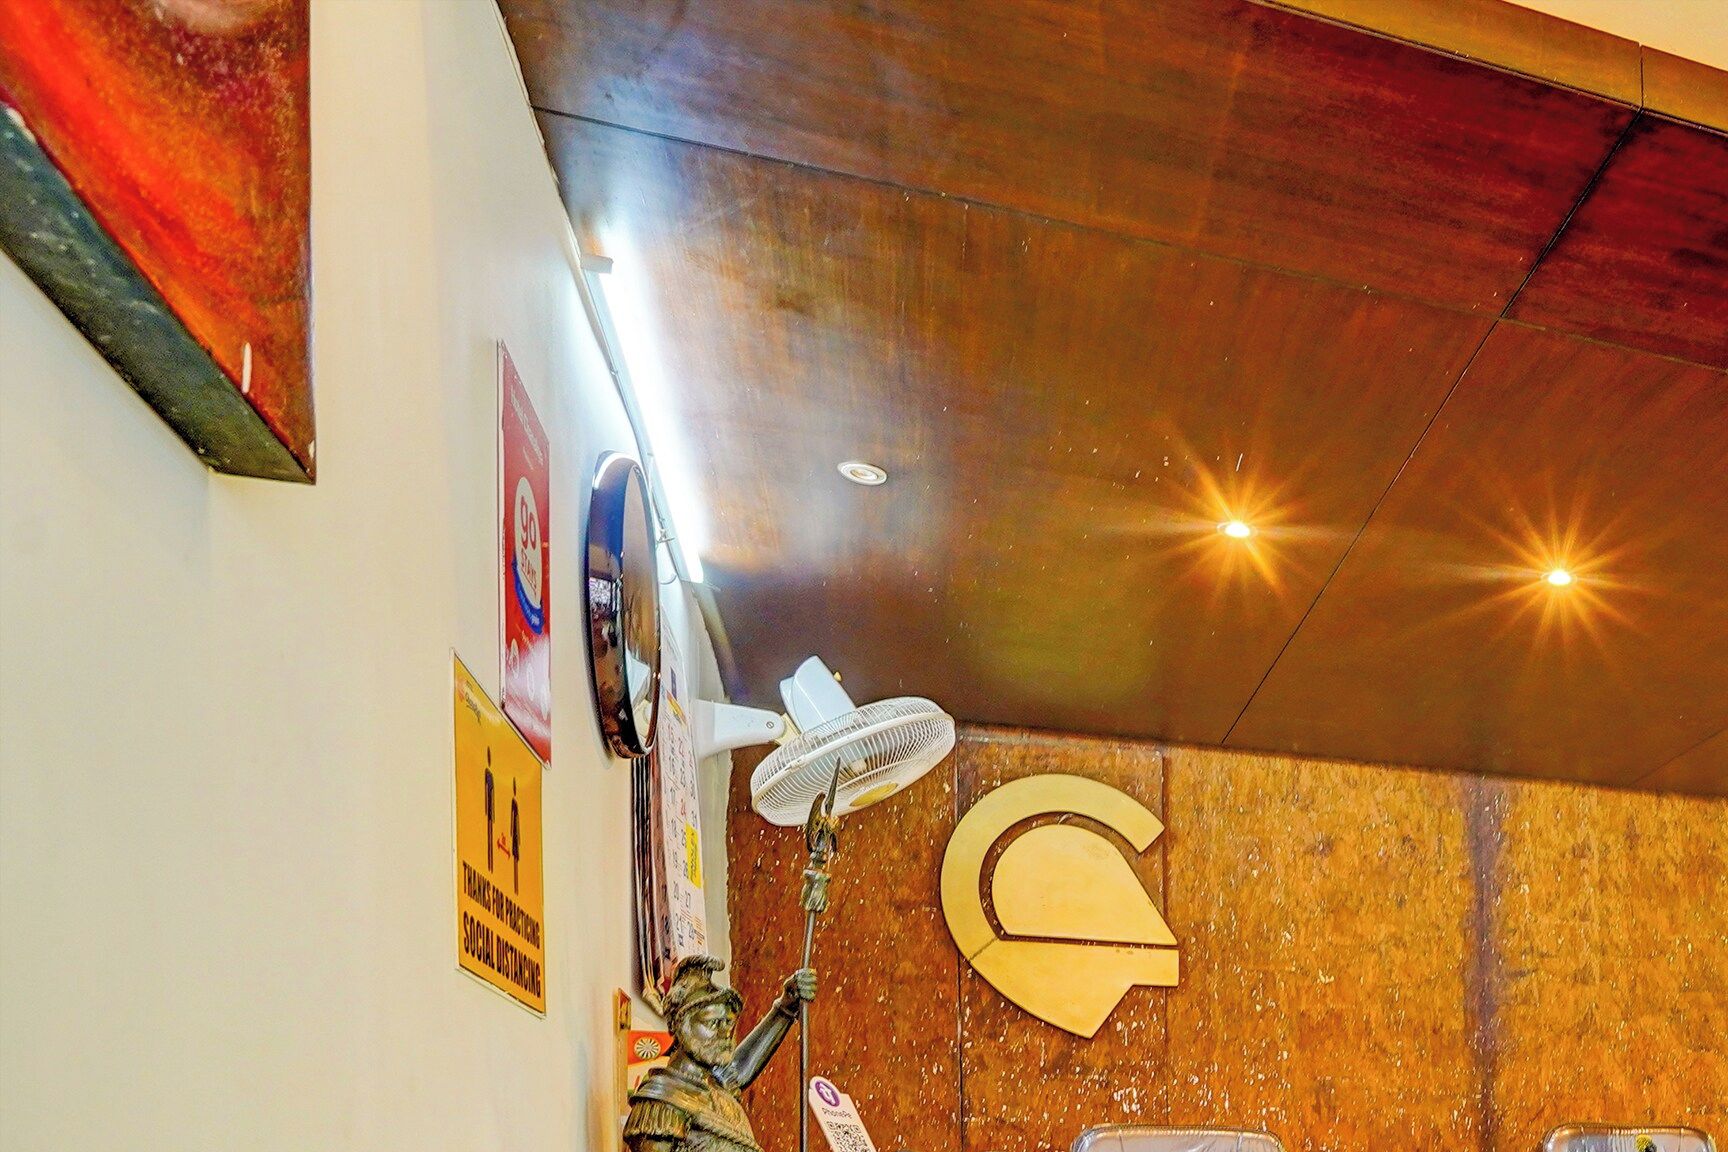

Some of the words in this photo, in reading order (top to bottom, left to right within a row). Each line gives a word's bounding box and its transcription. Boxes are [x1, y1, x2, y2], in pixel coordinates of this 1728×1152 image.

[520, 495, 537, 549] go
[463, 860, 491, 912] THANKS
[492, 885, 504, 921] FOR
[506, 896, 540, 949] PRACTICING
[463, 911, 495, 969] SOCIAL
[497, 936, 540, 998] DISTANCING
